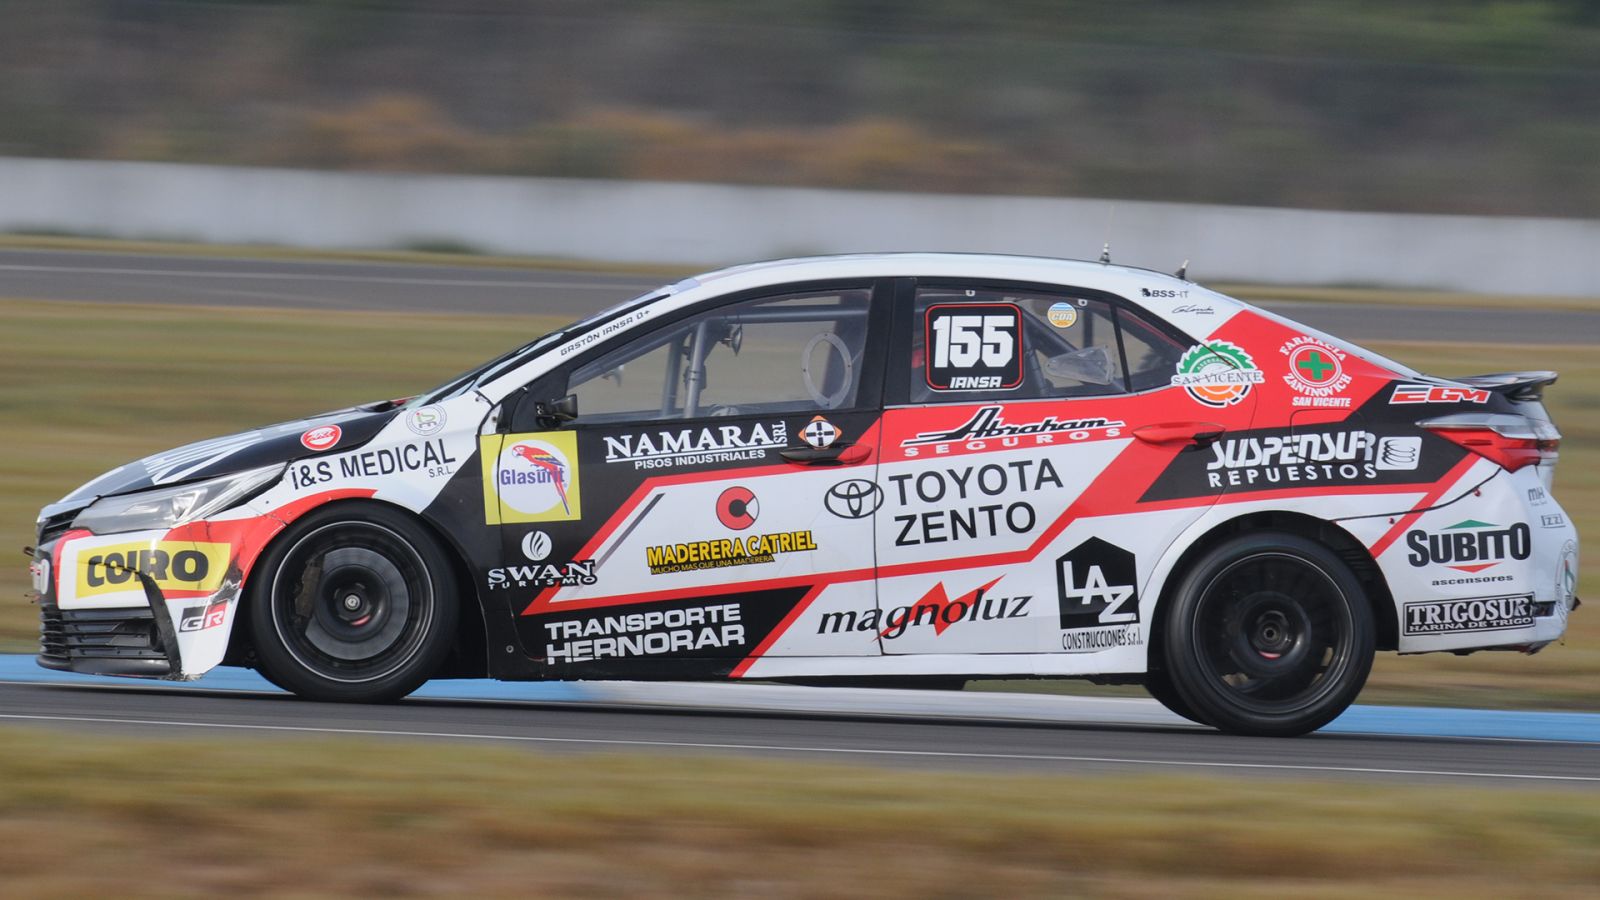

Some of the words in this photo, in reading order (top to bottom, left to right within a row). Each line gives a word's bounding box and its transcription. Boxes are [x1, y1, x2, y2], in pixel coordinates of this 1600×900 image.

[602, 318, 633, 336] IANSA
[933, 316, 1014, 368] 155
[1279, 336, 1346, 361] FARMACIA
[949, 375, 1002, 389] IANSA
[1172, 376, 1201, 385] SAN
[1205, 371, 1263, 383] VICENTE
[1292, 397, 1312, 407] SAN
[1313, 397, 1351, 407] VICENTE
[1388, 385, 1492, 404] EGM
[902, 406, 1125, 445] Abraham
[603, 423, 774, 458] NAMARA
[772, 421, 787, 443] SRL
[905, 428, 1121, 457] SEGUROS
[1207, 431, 1376, 470] SUSPENSUR
[340, 439, 456, 478] MEDICAL
[635, 457, 672, 469] PISOS
[675, 449, 765, 467] INDUSTRIALES
[429, 466, 454, 478] S.R.L.
[501, 468, 565, 485] Glasurit
[889, 458, 1063, 505] TOYOTA
[1207, 463, 1376, 488] REPUESTOS
[895, 502, 1036, 546] ZENTO
[647, 538, 745, 566] MADERERA
[747, 531, 817, 555] CATRIEL
[1406, 523, 1531, 567] SUBITO
[87, 550, 208, 587] COIRO
[488, 562, 593, 583] SWAN
[651, 565, 681, 574] MUCHO
[681, 563, 699, 572] MAS
[699, 562, 715, 570] QUE
[716, 560, 733, 568] UNA
[488, 576, 597, 590] TURISMO
[1063, 561, 1137, 623] LAZ
[1432, 575, 1513, 586] ascensores
[181, 610, 224, 630] GR
[544, 604, 741, 640] TRANSPORTE
[817, 589, 1033, 639] magnoluz
[1408, 597, 1529, 626] TRIGOSUR
[1409, 622, 1465, 632] HARINA
[1468, 620, 1487, 629] DE
[1490, 617, 1531, 627] TRIGO
[546, 625, 745, 665] HERNORAR
[1062, 629, 1127, 650] CONSTRUCCIONES
